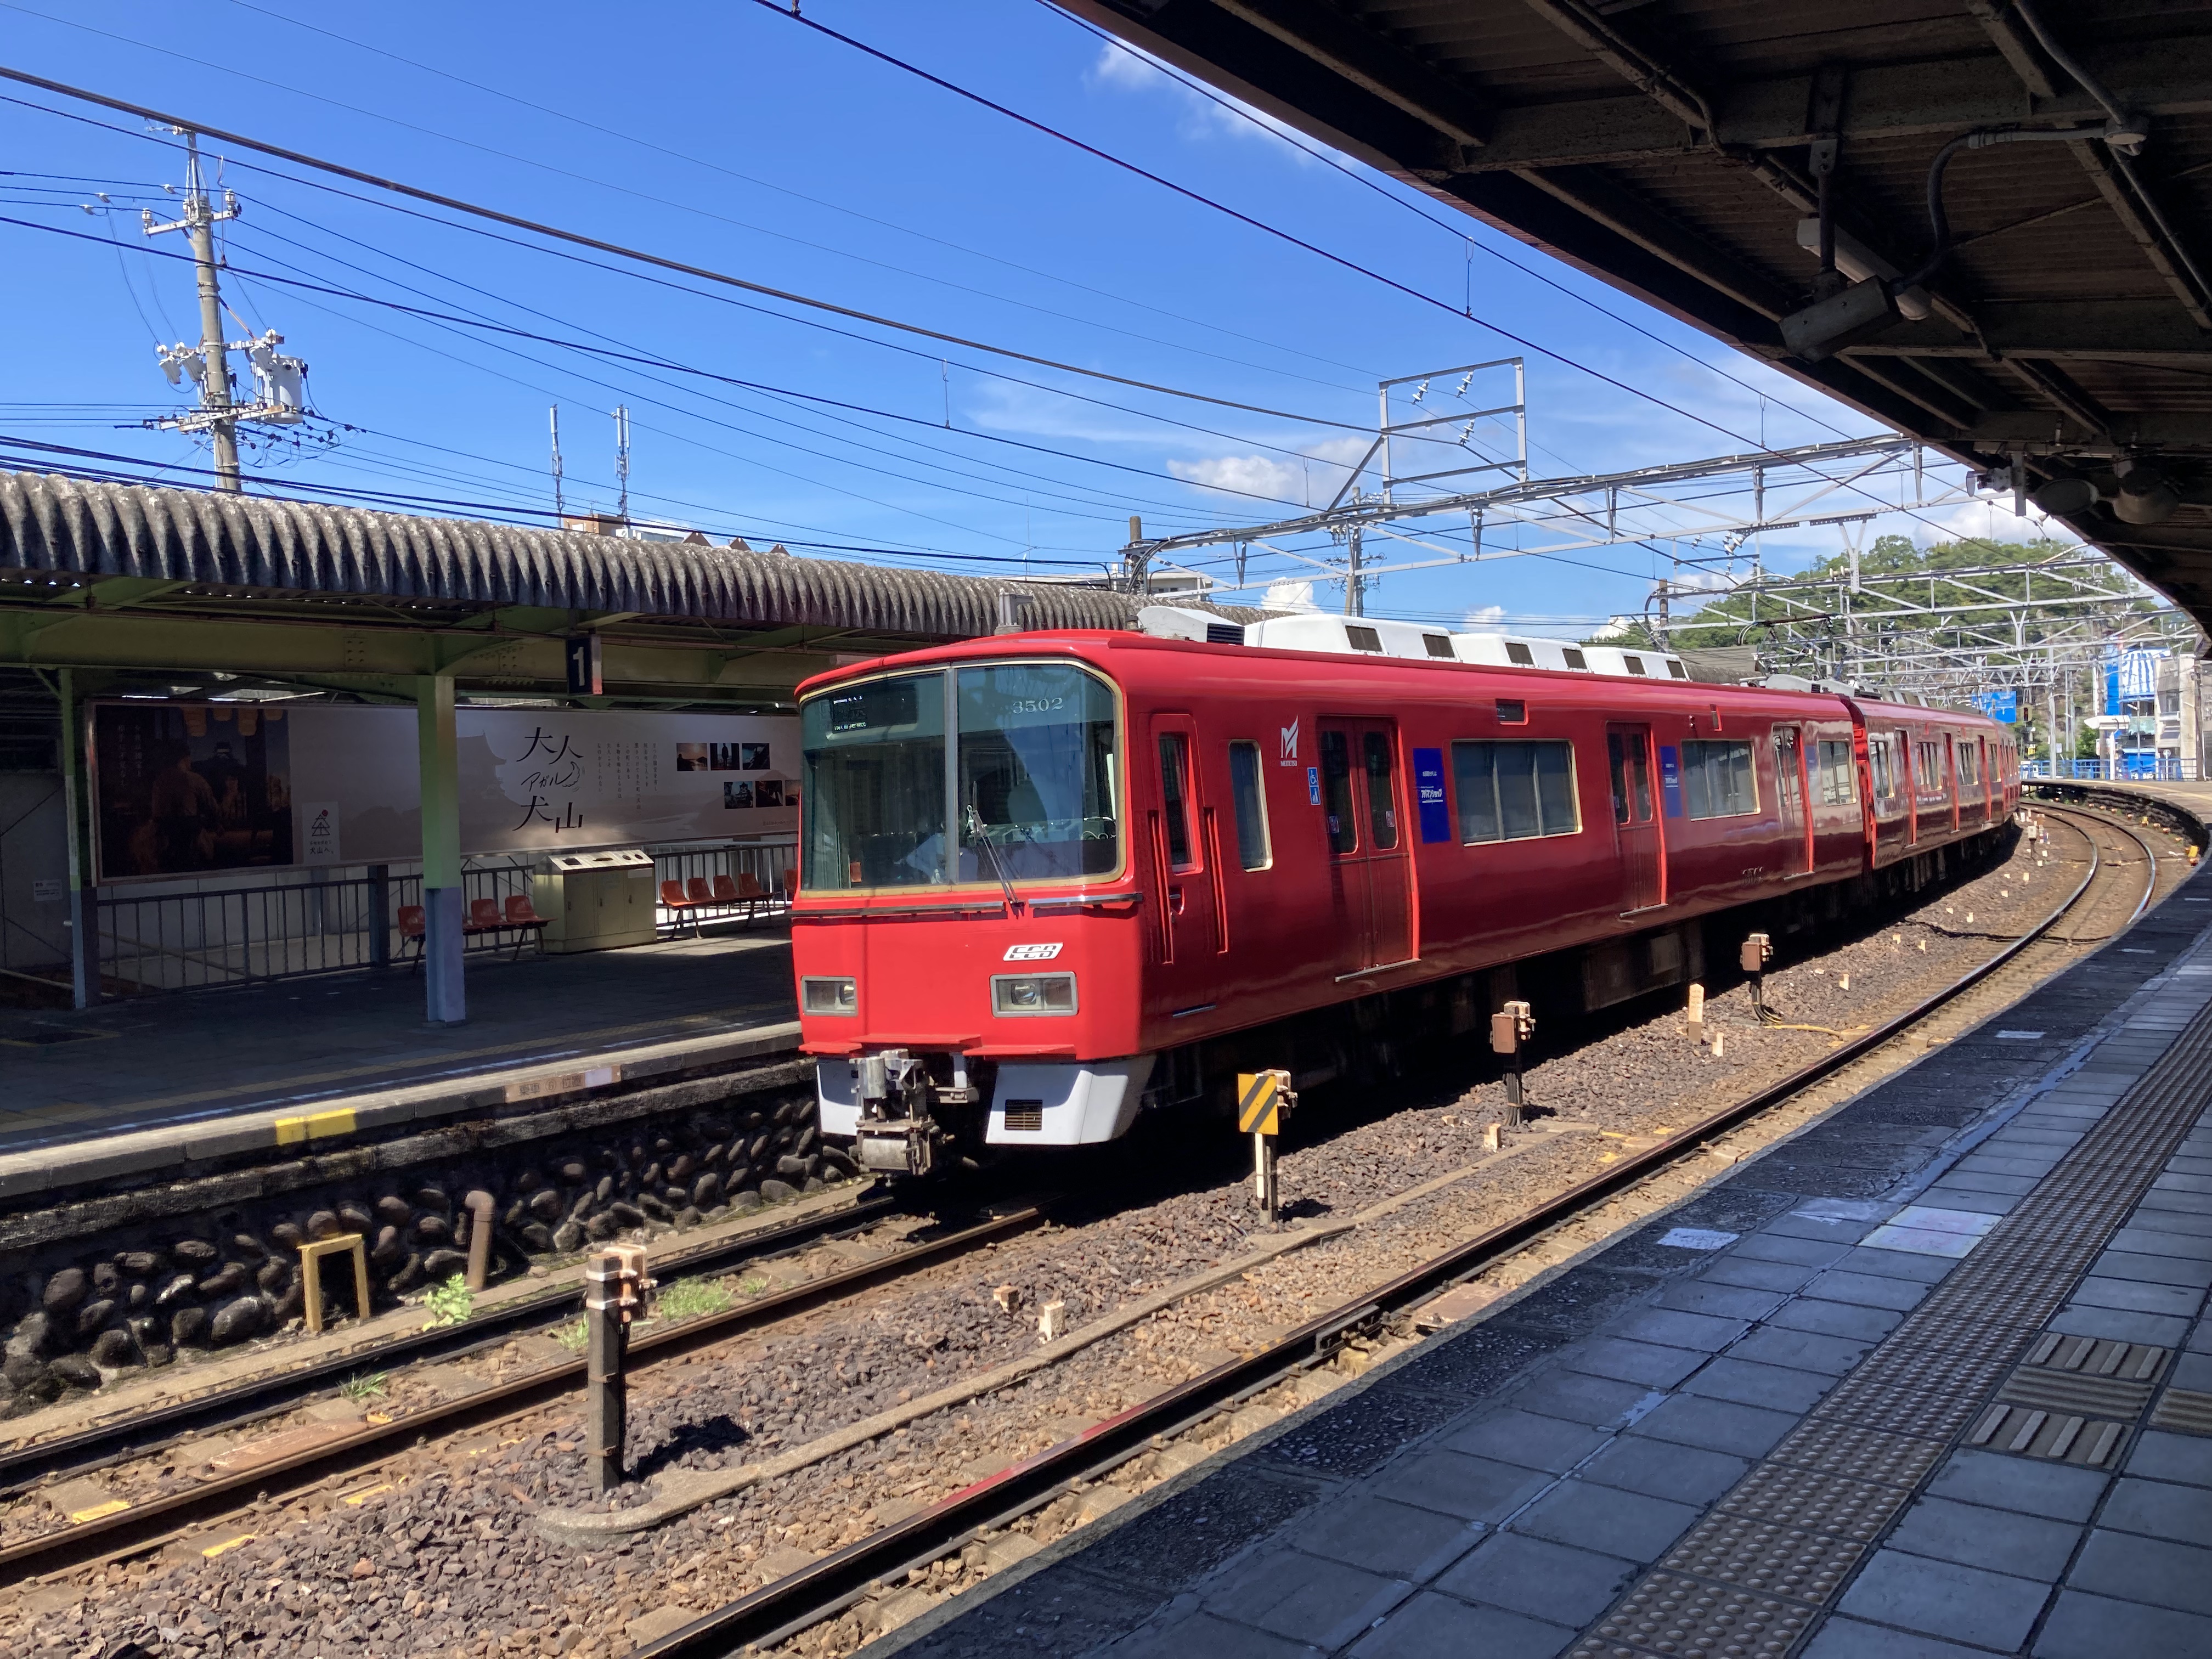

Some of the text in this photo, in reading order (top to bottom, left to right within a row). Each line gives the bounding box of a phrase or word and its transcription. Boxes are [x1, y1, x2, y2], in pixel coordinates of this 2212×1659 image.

[573, 646, 585, 686] 1
[1013, 697, 1063, 714] 3502
[516, 726, 584, 764] 大人
[512, 795, 583, 833] 犬山
[562, 1075, 582, 1089] 位置
